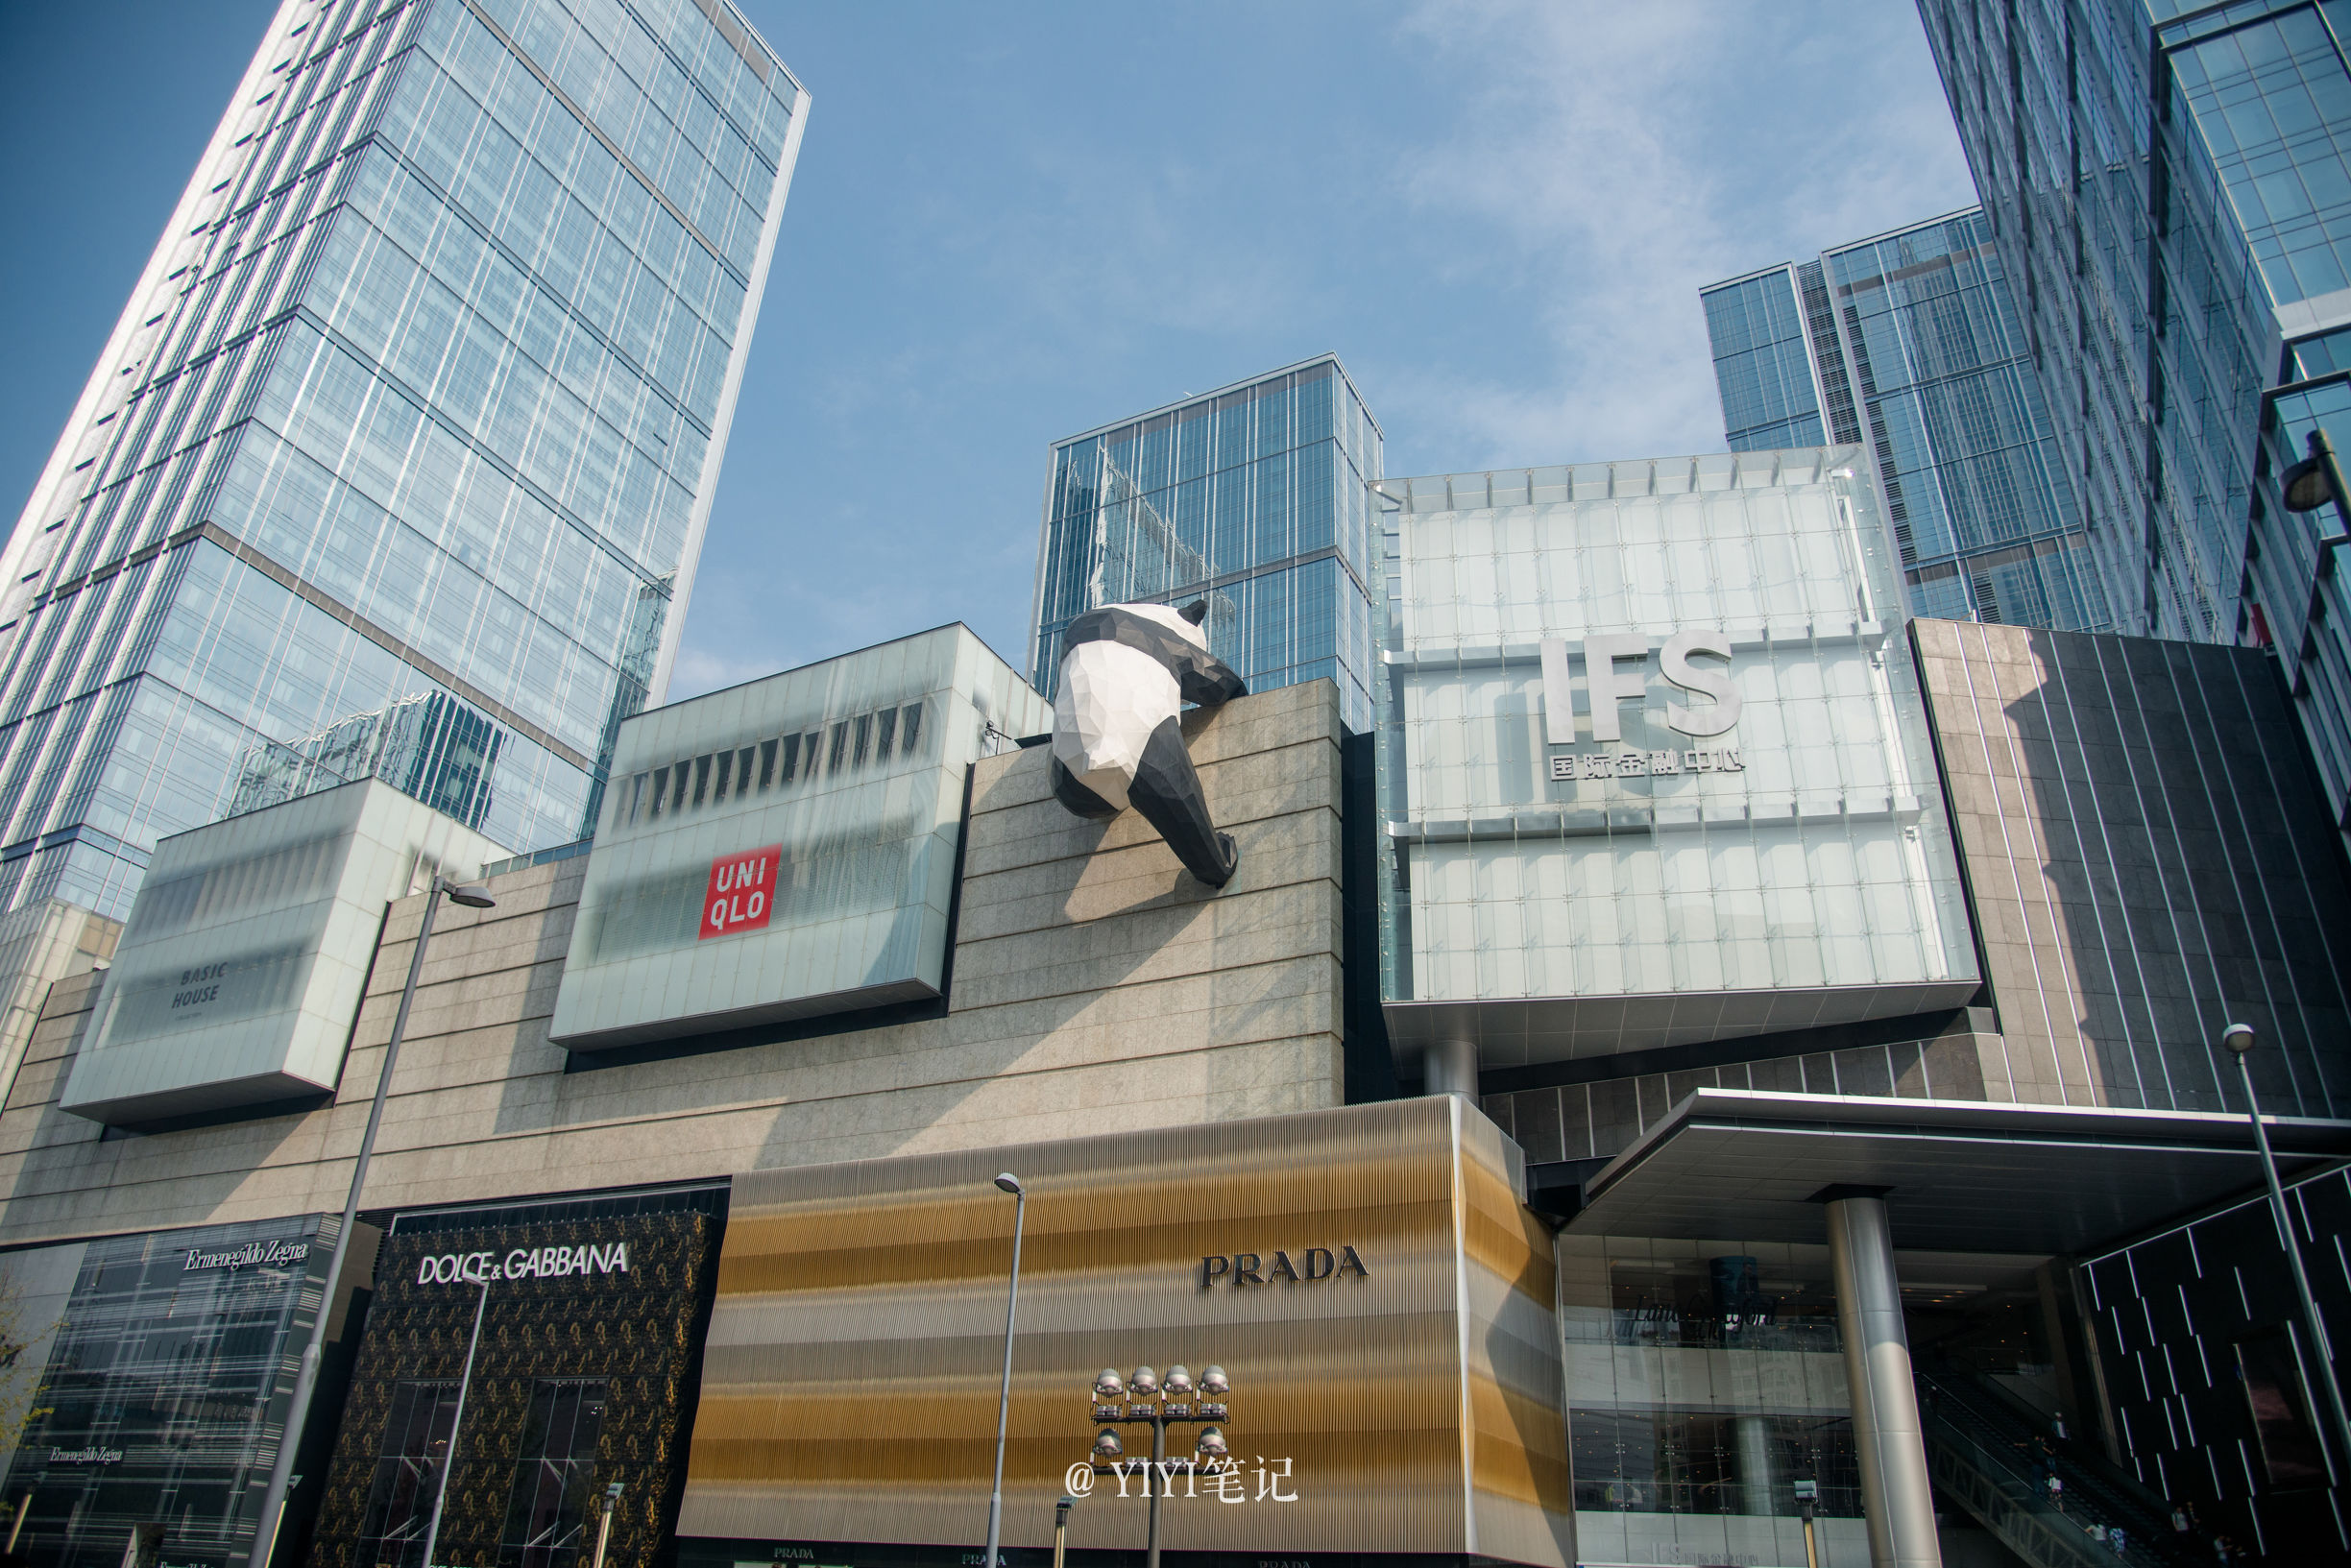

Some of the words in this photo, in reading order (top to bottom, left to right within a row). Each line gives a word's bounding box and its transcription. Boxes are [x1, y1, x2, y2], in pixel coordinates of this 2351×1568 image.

[1539, 629, 1742, 745] IFS
[1549, 747, 1746, 782] 国际金融中心
[716, 856, 766, 893] UNI
[711, 891, 764, 930] QLO
[181, 961, 229, 986] BASIC
[172, 984, 221, 1009] HOUSE
[183, 1242, 265, 1270] Ermenegildo
[264, 1240, 308, 1266] Zegna
[1201, 1245, 1370, 1288] PRADA
[1686, 1293, 1779, 1334] Cwford
[97, 1446, 123, 1465] Zegna
[773, 1547, 814, 1558] PRADA
[961, 1553, 1007, 1566] PRAA
